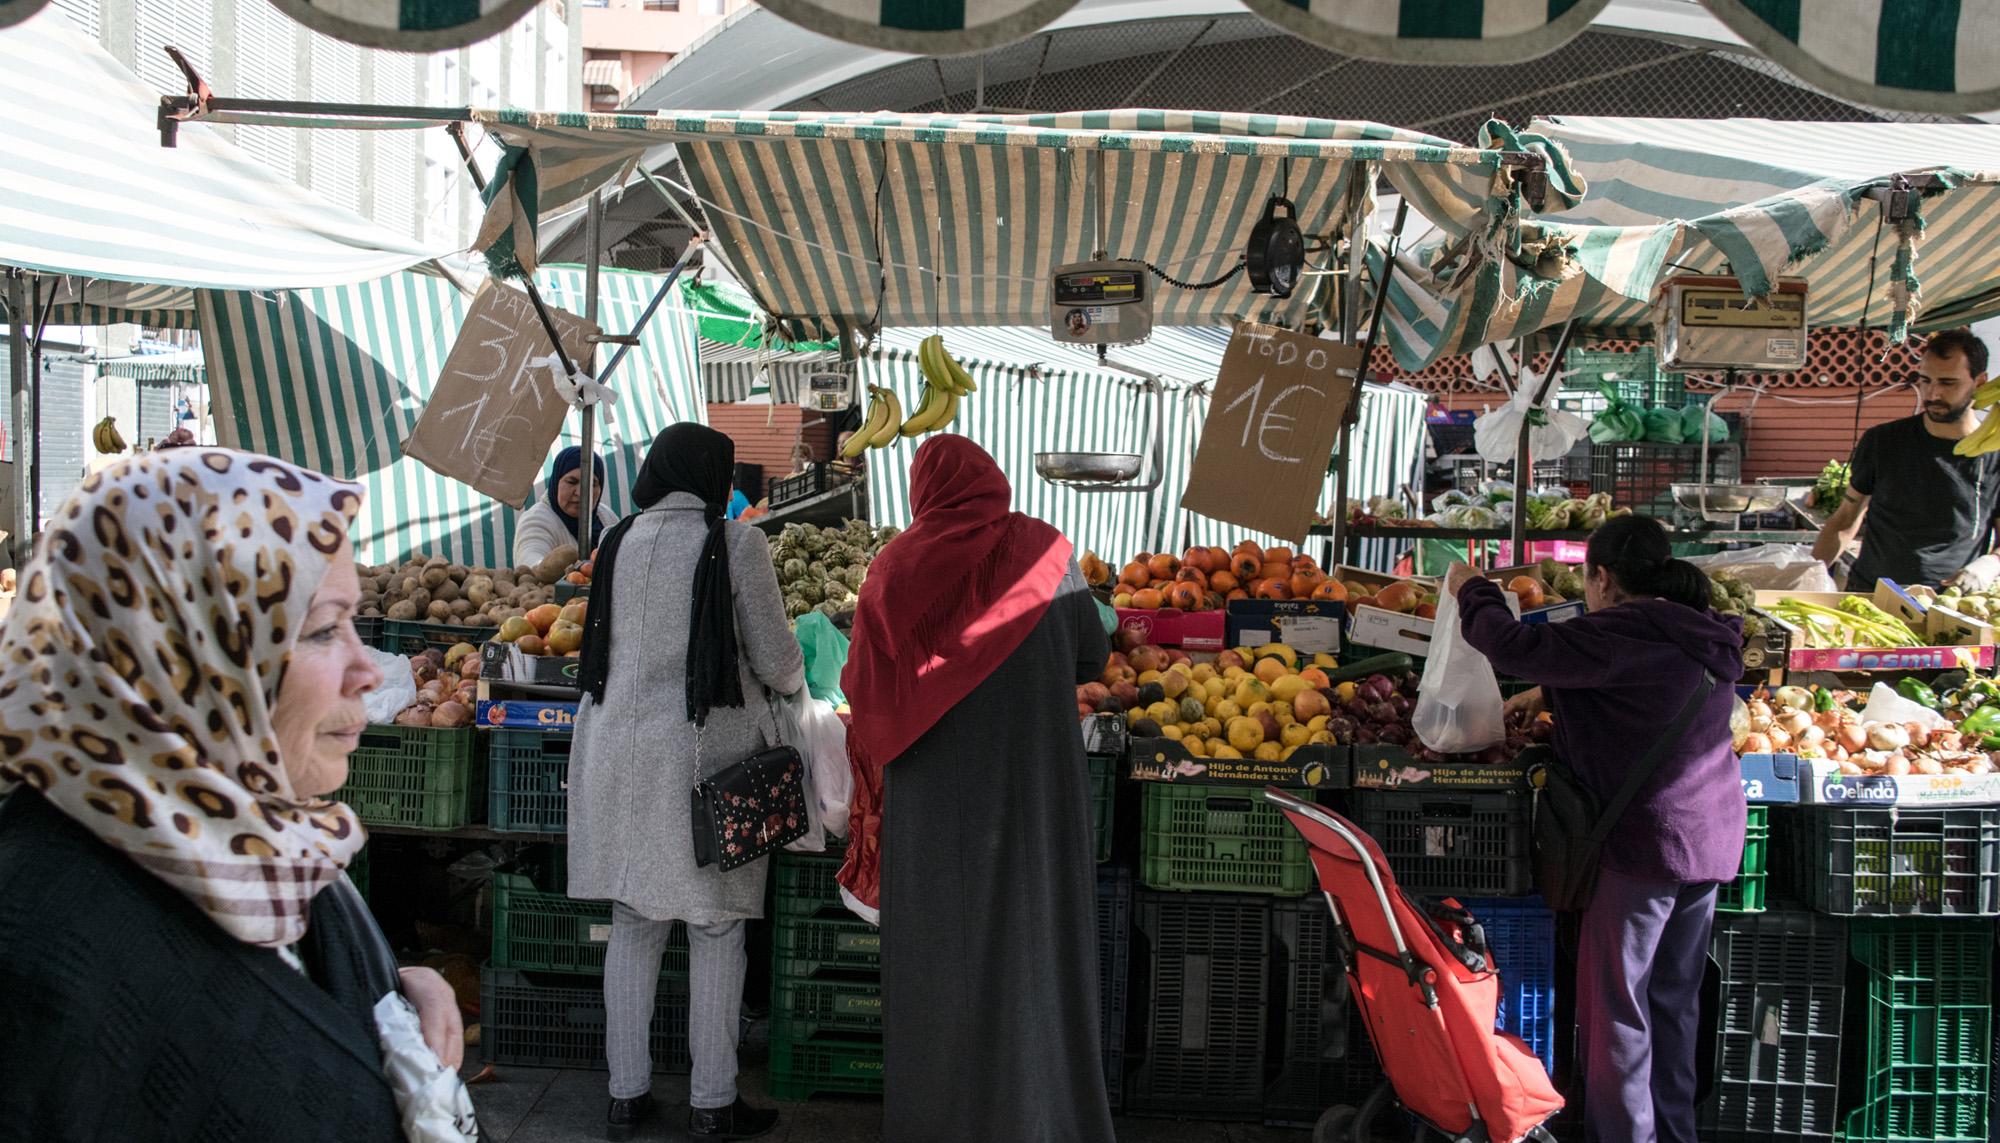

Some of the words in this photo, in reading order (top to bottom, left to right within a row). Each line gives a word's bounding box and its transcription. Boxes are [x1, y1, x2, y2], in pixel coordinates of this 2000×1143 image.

[1241, 332, 1328, 370] TODO
[1223, 373, 1326, 463] 1€
[440, 392, 534, 485] 1€
[1208, 762, 1232, 773] Hijo
[1236, 763, 1249, 772] de
[1253, 764, 1298, 774] Antonio
[1208, 770, 1268, 781] Hernández
[1433, 768, 1457, 778] Hijo
[1460, 769, 1473, 777] de
[1477, 769, 1523, 777] Antonio
[1825, 781, 1896, 800] Melinda
